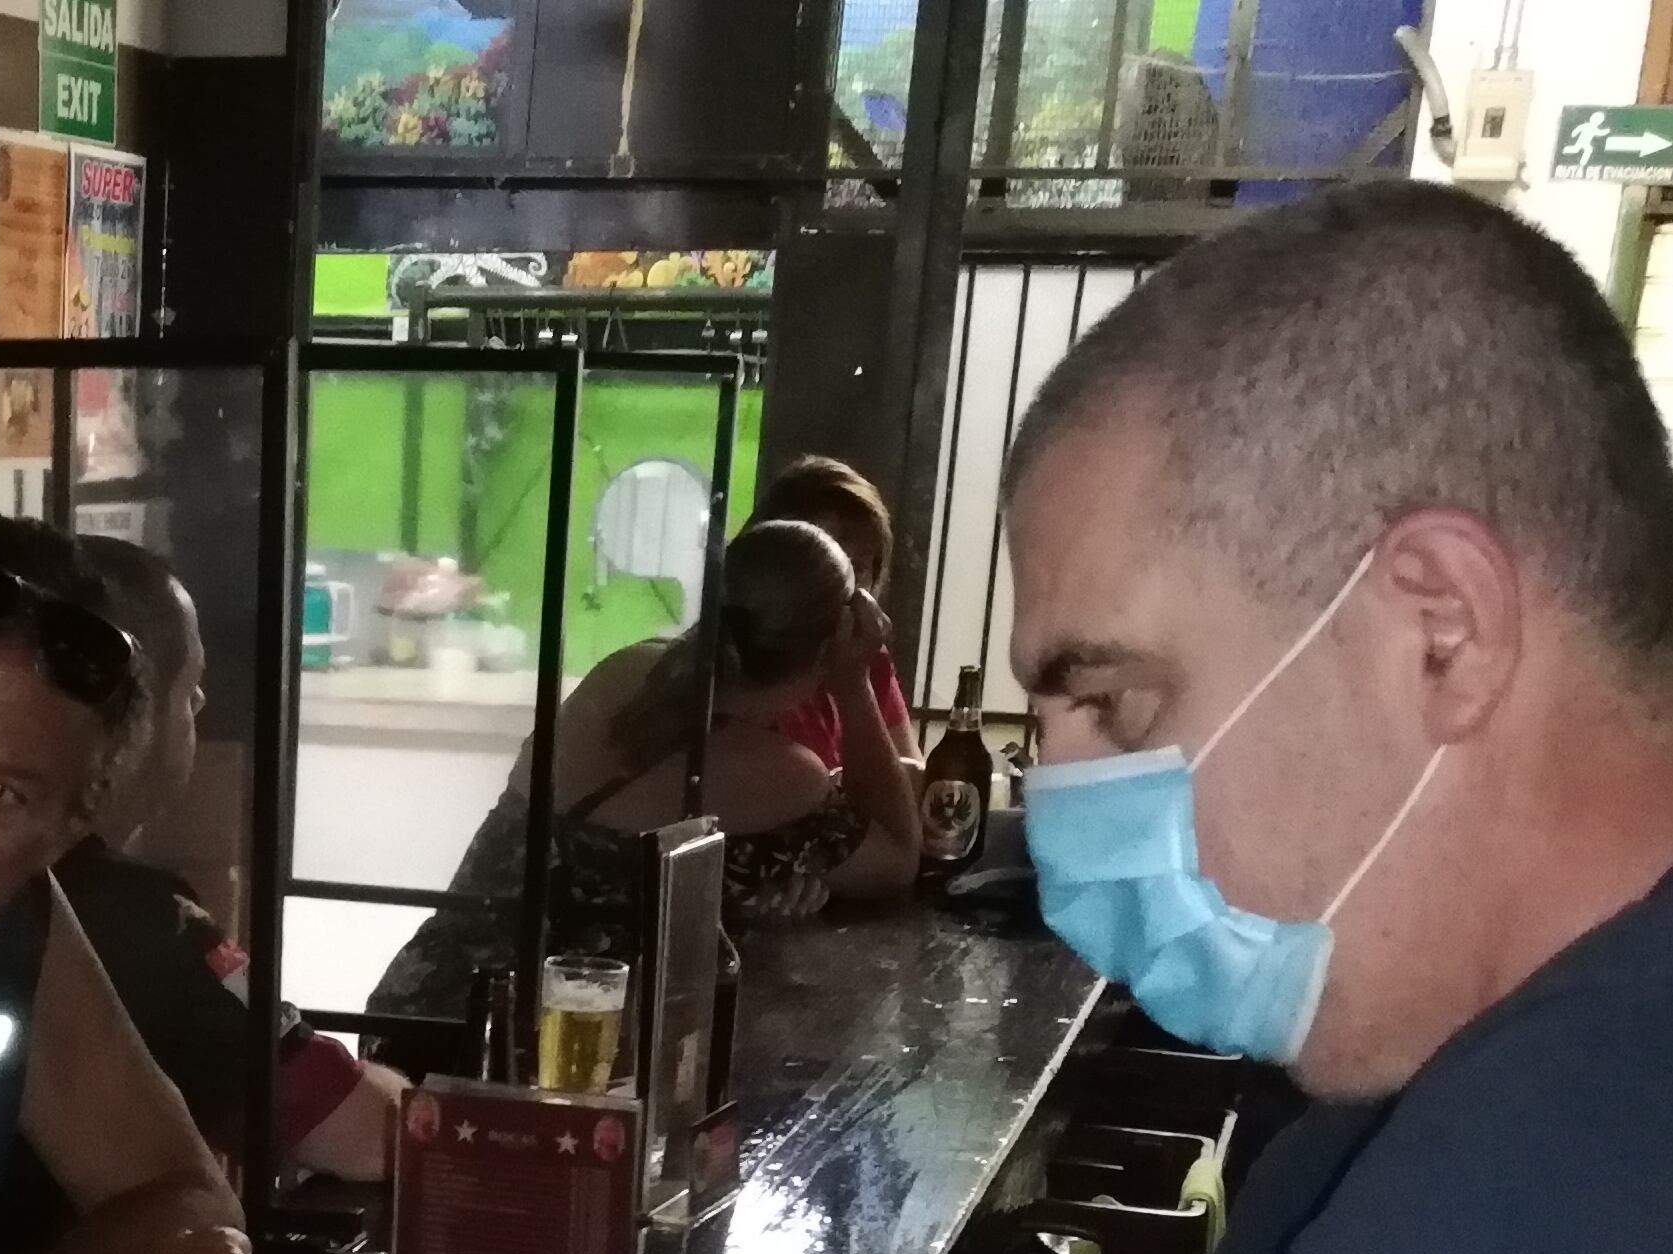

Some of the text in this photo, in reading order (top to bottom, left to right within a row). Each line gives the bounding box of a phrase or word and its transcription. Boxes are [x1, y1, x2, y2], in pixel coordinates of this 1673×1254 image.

[44, 0, 115, 53] SALIDA
[56, 73, 103, 126] EXIT
[83, 161, 135, 203] SUPER
